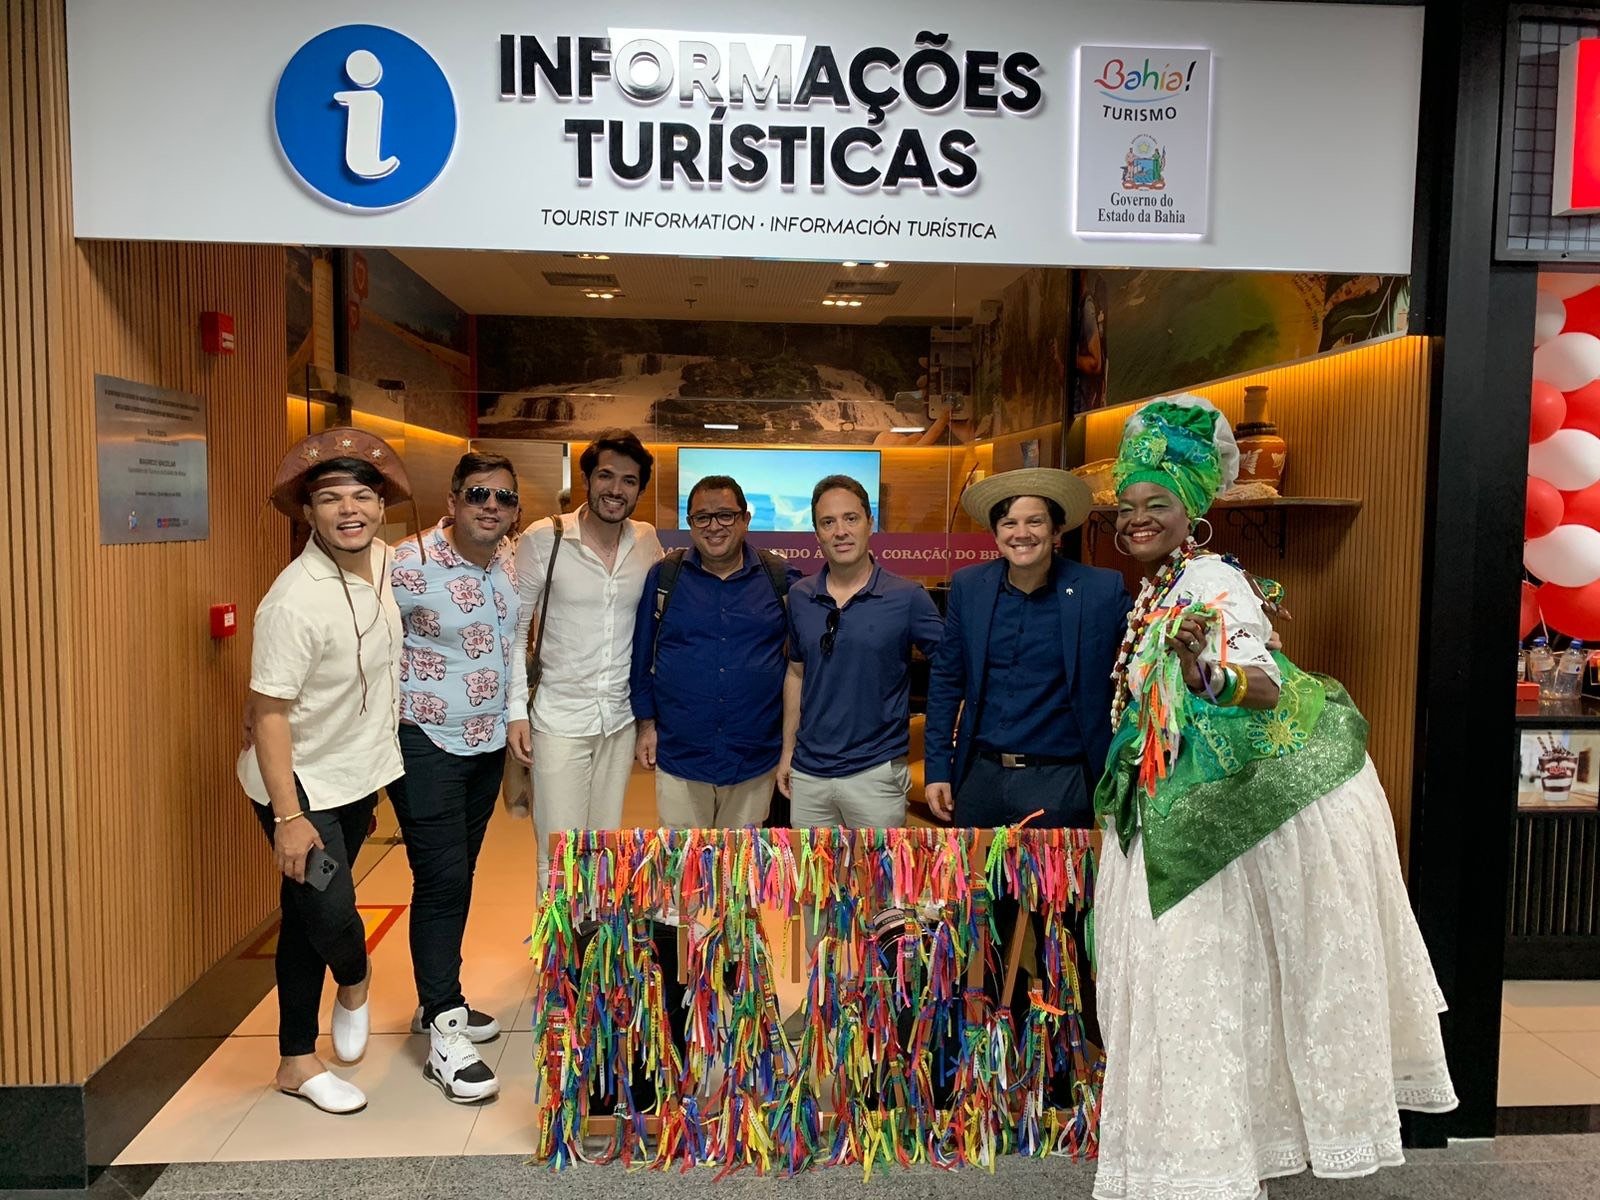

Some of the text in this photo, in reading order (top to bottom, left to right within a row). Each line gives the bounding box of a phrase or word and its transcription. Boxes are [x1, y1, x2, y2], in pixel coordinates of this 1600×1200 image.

[499, 30, 1042, 126] INFORMAÇÕES
[1102, 104, 1178, 122] TURISMO
[564, 105, 978, 190] TURÍSTICAS
[1110, 192, 1174, 207] Governo do
[541, 208, 997, 239] TOURIST INFORMATION INFORMACIÓN TURÍSTICA
[1098, 208, 1186, 224] Estado da Bahia
[881, 547, 951, 562] CORAÇÃO
[955, 549, 976, 560] DO
